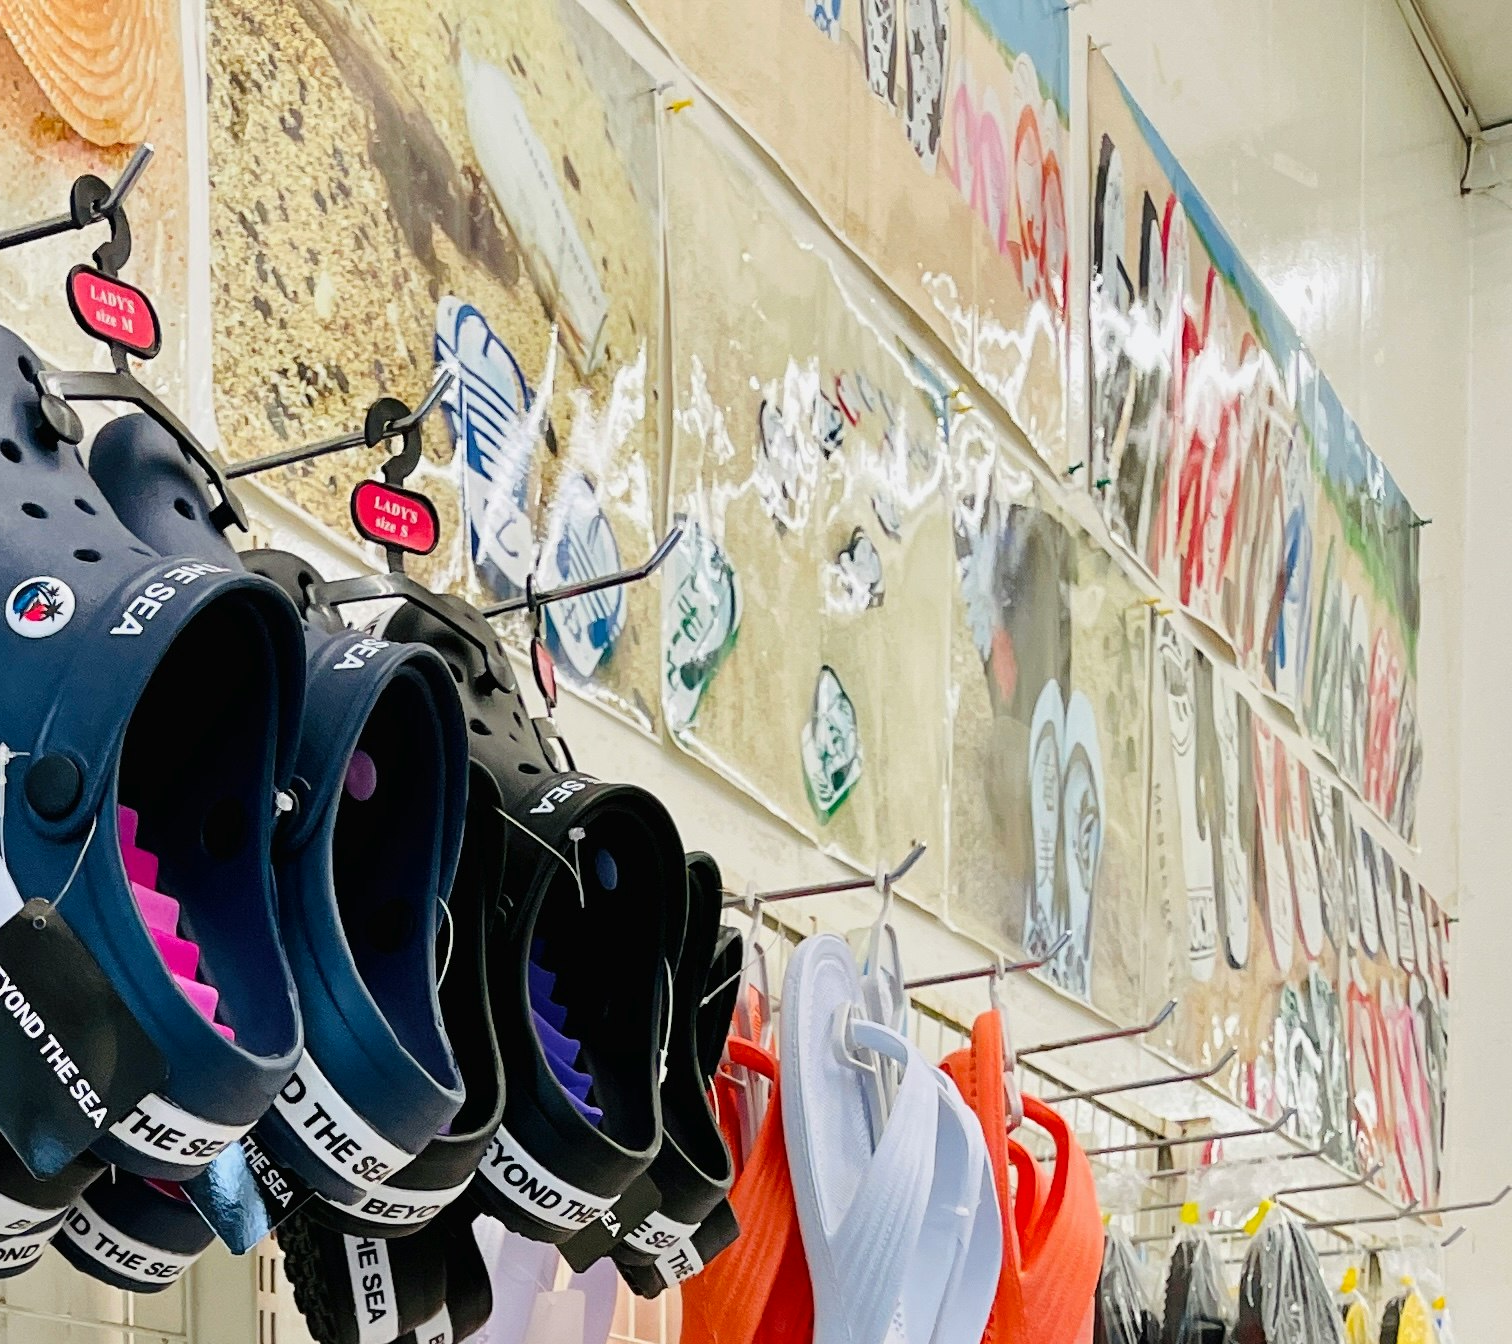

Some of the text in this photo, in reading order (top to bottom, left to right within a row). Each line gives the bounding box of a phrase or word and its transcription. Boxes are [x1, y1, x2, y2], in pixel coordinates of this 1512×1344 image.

[89, 283, 135, 316] LADY'S
[95, 310, 134, 335] size M
[373, 495, 420, 525] LADY'S
[375, 517, 410, 538] size S
[109, 573, 178, 637] SEA
[334, 638, 390, 671] SEA
[529, 780, 586, 814] SEA
[39, 1035, 79, 1085] THE
[69, 1077, 110, 1129] SEA
[115, 1105, 181, 1153] THE
[302, 1107, 362, 1164] THE
[240, 1133, 292, 1209] THE SEA
[487, 1138, 562, 1209] EYOND
[361, 1198, 433, 1220] BEYO
[600, 1208, 621, 1237] EA
[92, 1234, 145, 1271] THE
[357, 1237, 389, 1324] HE SEA
